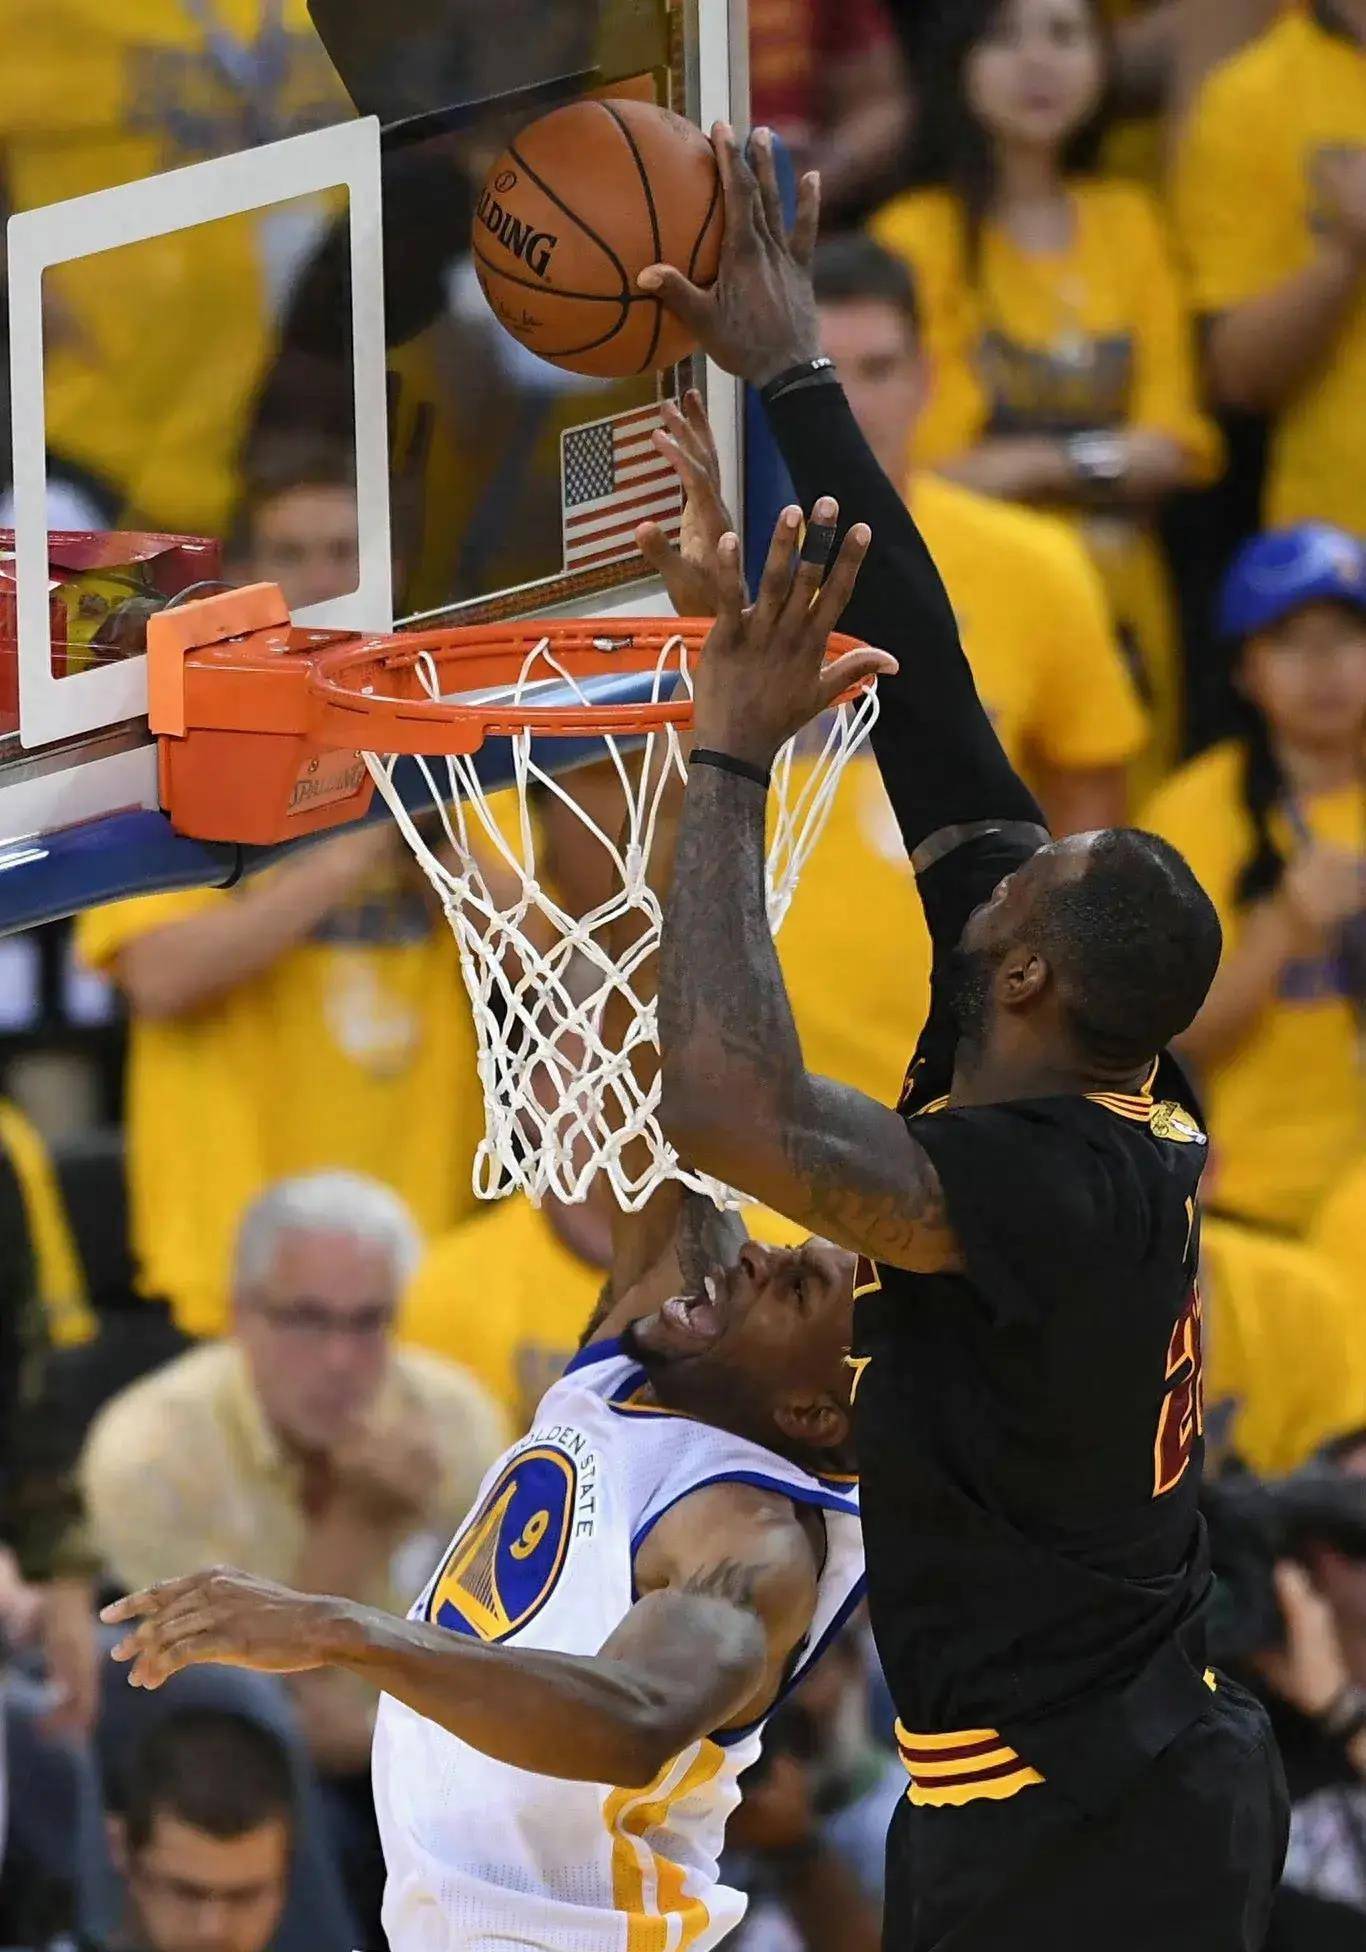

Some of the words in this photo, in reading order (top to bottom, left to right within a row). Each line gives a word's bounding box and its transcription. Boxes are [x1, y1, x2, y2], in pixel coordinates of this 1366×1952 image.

[477, 188, 558, 278] LDING
[1152, 1278, 1203, 1498] 2
[513, 1425, 586, 1456] OLDEN
[576, 1454, 595, 1537] STATE
[509, 1509, 549, 1560] 9
